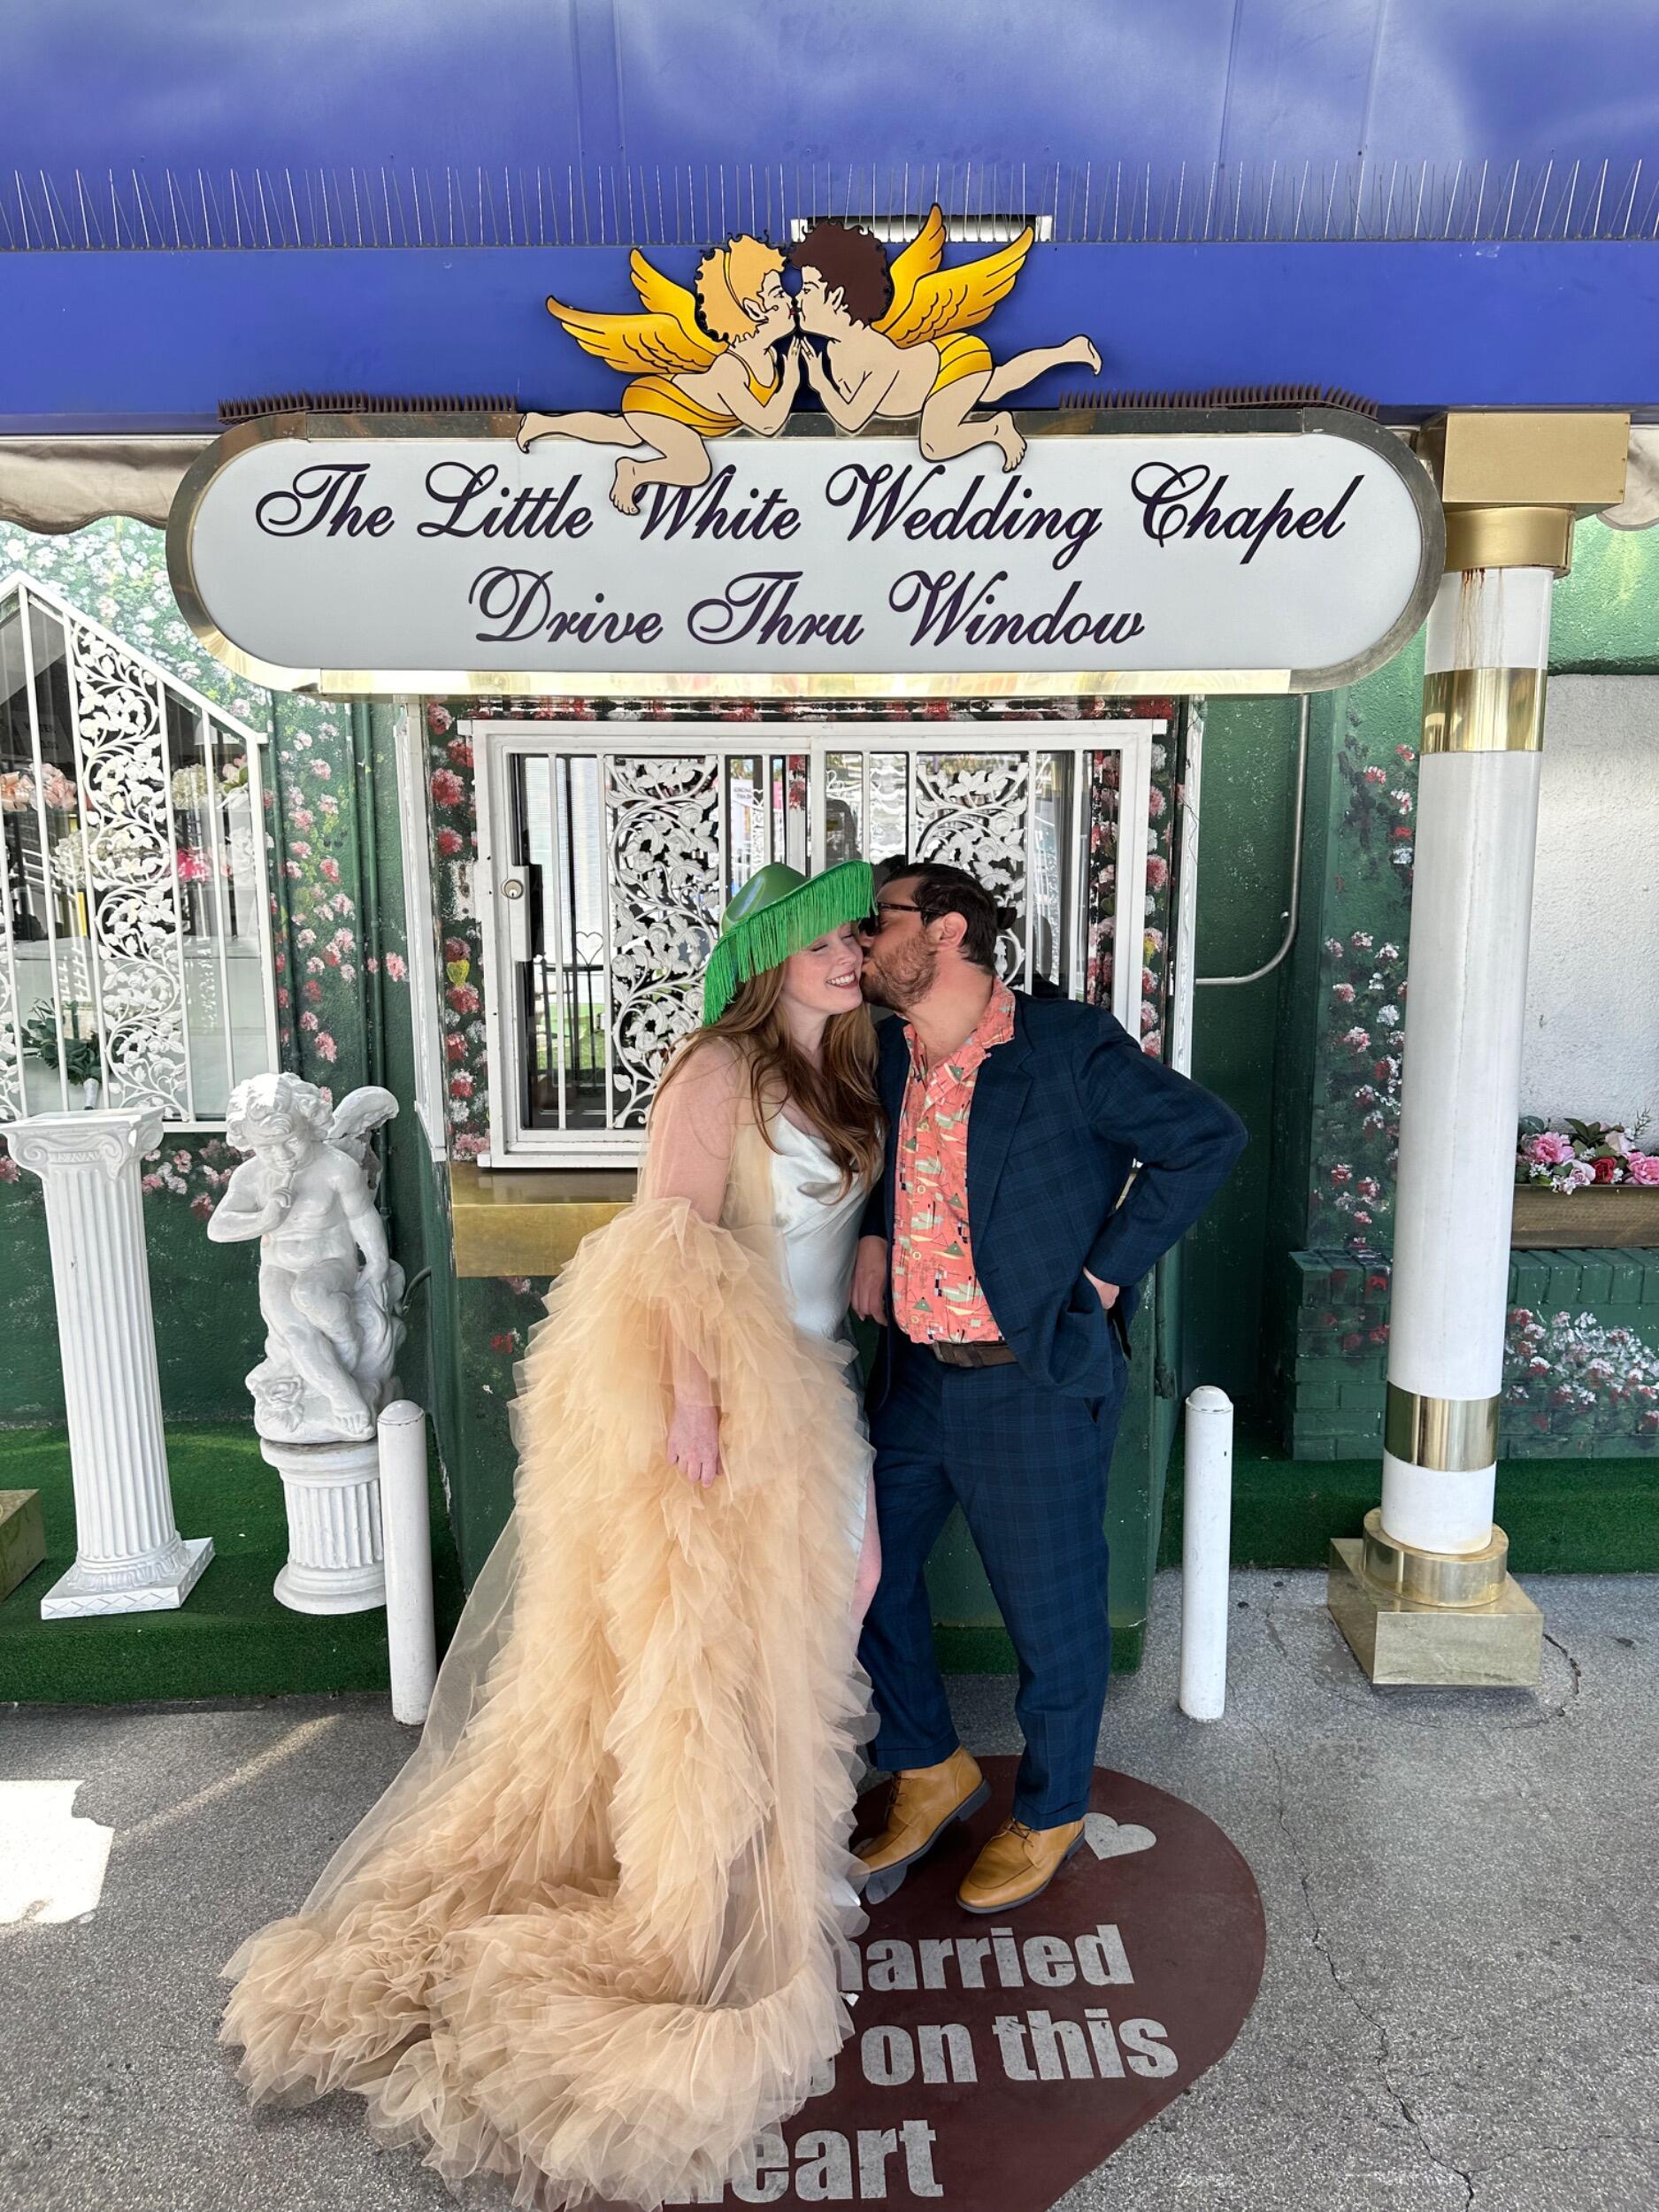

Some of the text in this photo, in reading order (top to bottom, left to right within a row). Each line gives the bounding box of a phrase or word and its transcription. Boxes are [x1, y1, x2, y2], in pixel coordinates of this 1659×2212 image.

[256, 461, 1365, 571] The Little White Wedding Chapel
[468, 565, 1145, 647] Drive Thru Window
[860, 2023, 979, 2086] on
[992, 2008, 1179, 2082] this
